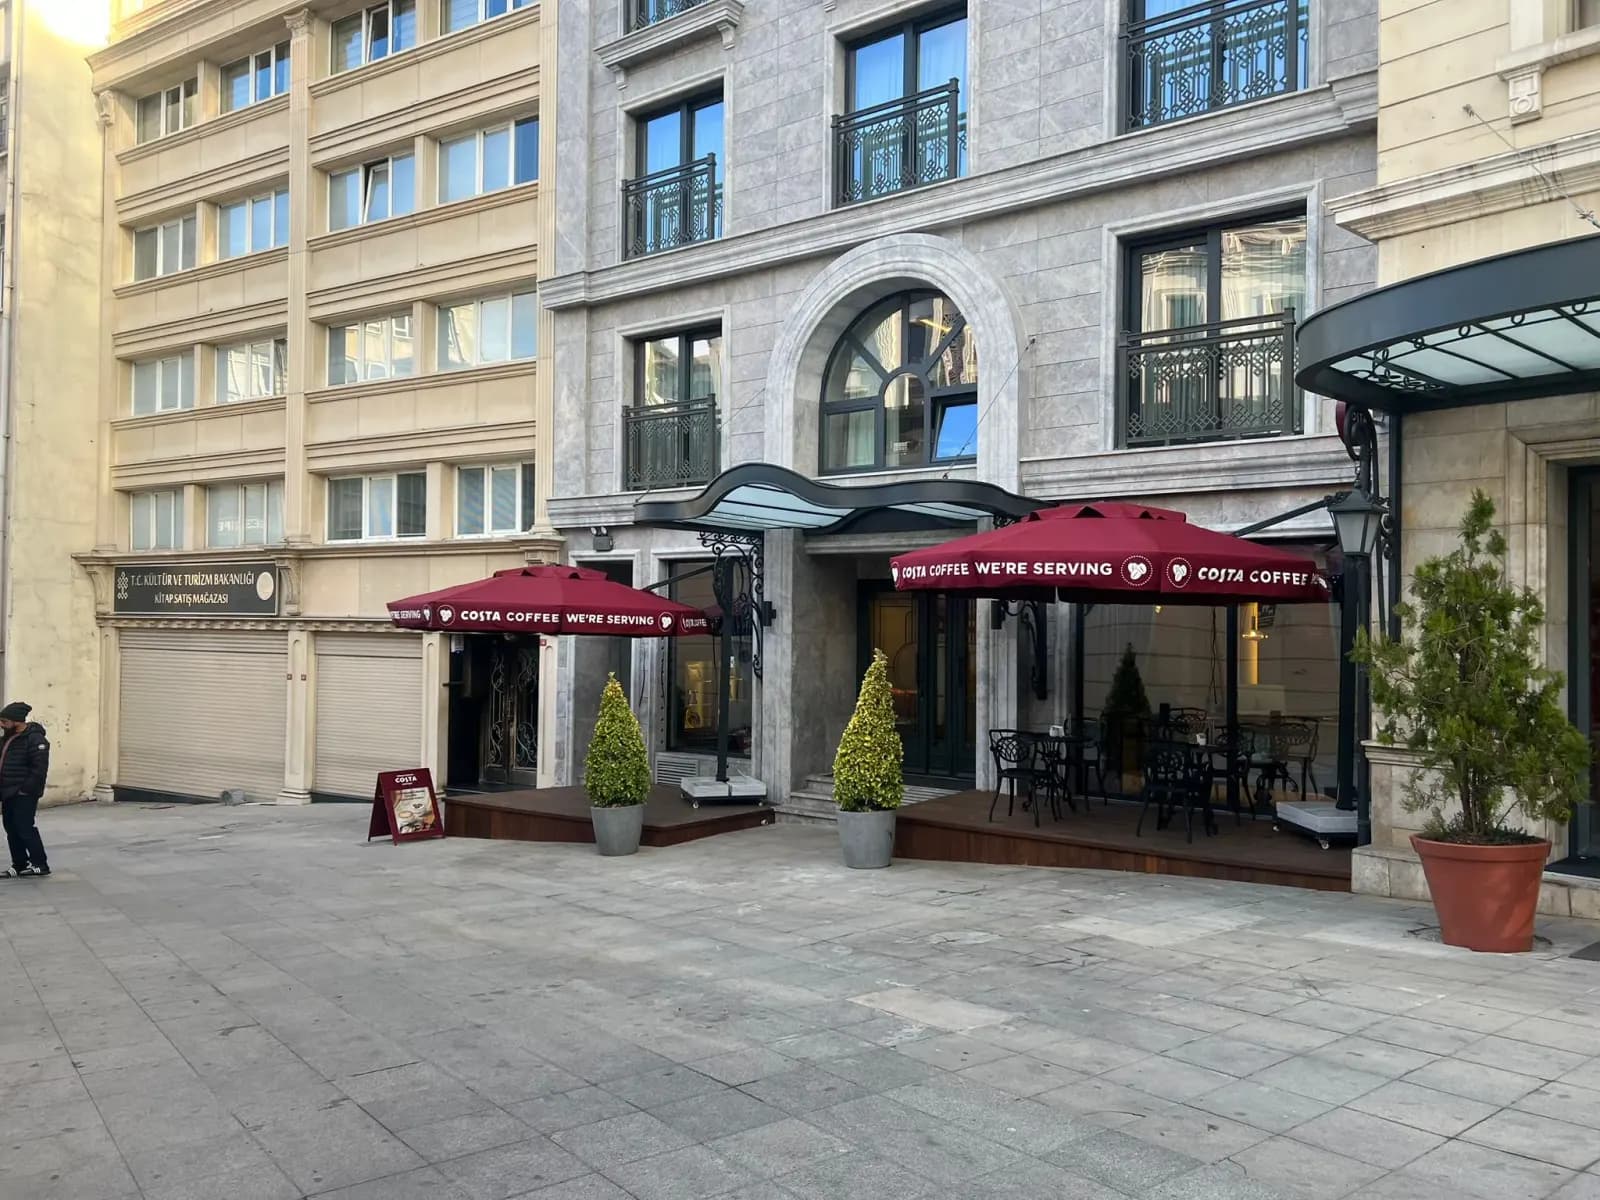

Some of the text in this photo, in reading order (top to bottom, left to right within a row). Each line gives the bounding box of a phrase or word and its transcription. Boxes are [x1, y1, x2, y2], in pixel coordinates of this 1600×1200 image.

[902, 563, 969, 580] COSTA COFFEE
[974, 561, 1113, 576] WE'RE SERVING
[144, 572, 172, 586] KÜLTÜR
[173, 574, 183, 586] VE
[184, 571, 213, 586] TURİZM
[214, 570, 255, 585] BAKANLIĞI
[1198, 567, 1244, 582] COSTA
[1249, 570, 1308, 586] COFFEE
[154, 591, 173, 604] KİTAP
[193, 592, 229, 604] MAĞAZASI
[460, 610, 560, 623] COSTA COFFEE
[566, 613, 654, 626] WE'RE SERVING
[394, 775, 418, 784] COSTA
